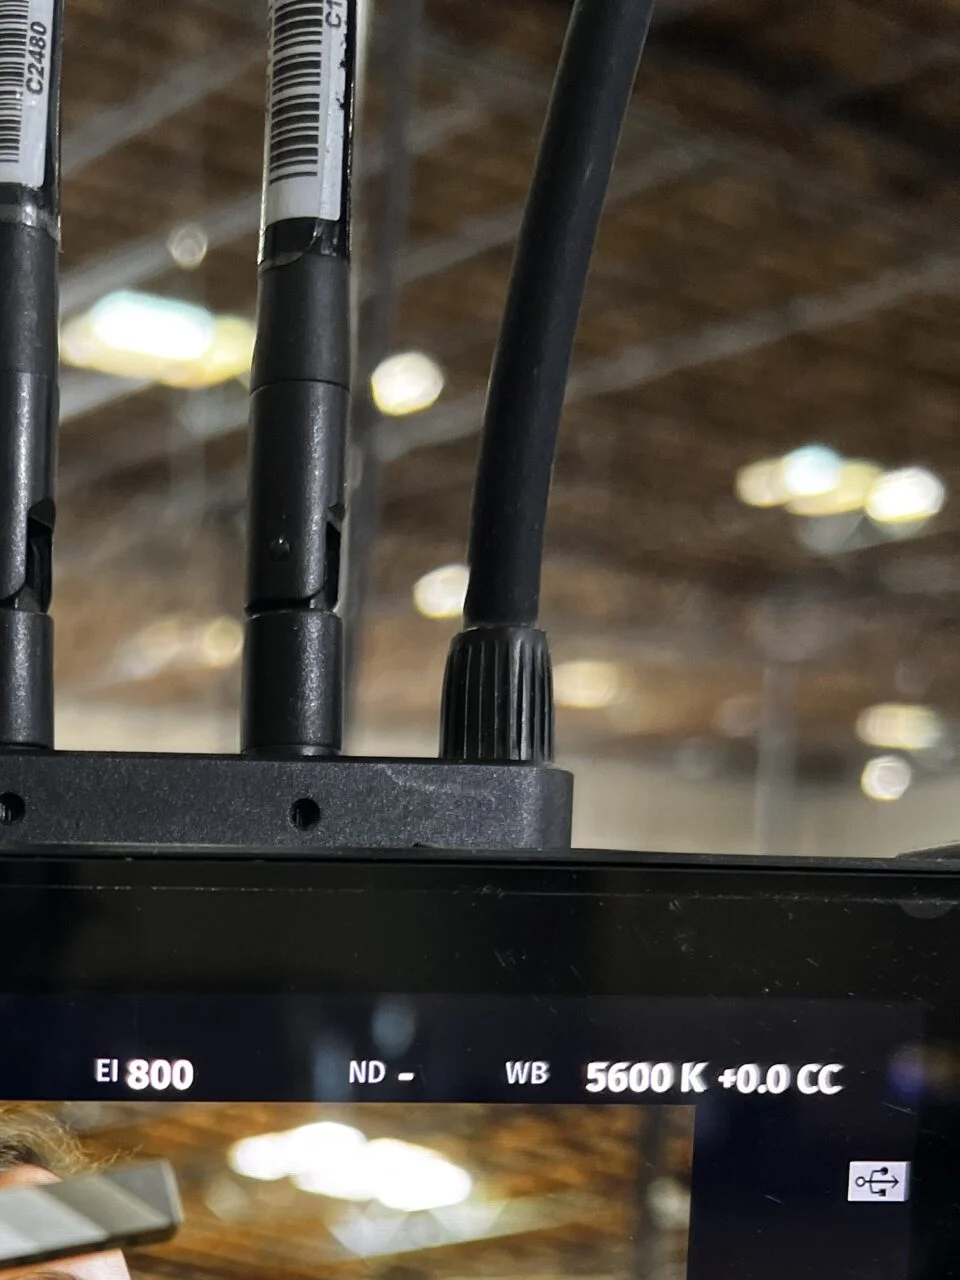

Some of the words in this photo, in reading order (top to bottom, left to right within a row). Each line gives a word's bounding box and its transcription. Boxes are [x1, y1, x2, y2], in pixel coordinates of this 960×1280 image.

[25, 21, 47, 95] C2480
[95, 1058, 118, 1082] EI
[126, 1059, 194, 1090] 800
[349, 1060, 386, 1083] ND
[505, 1061, 551, 1085] WB
[586, 1061, 676, 1093] 5600
[680, 1061, 709, 1093] K
[717, 1063, 791, 1094] +0.0
[796, 1063, 844, 1095] CC
